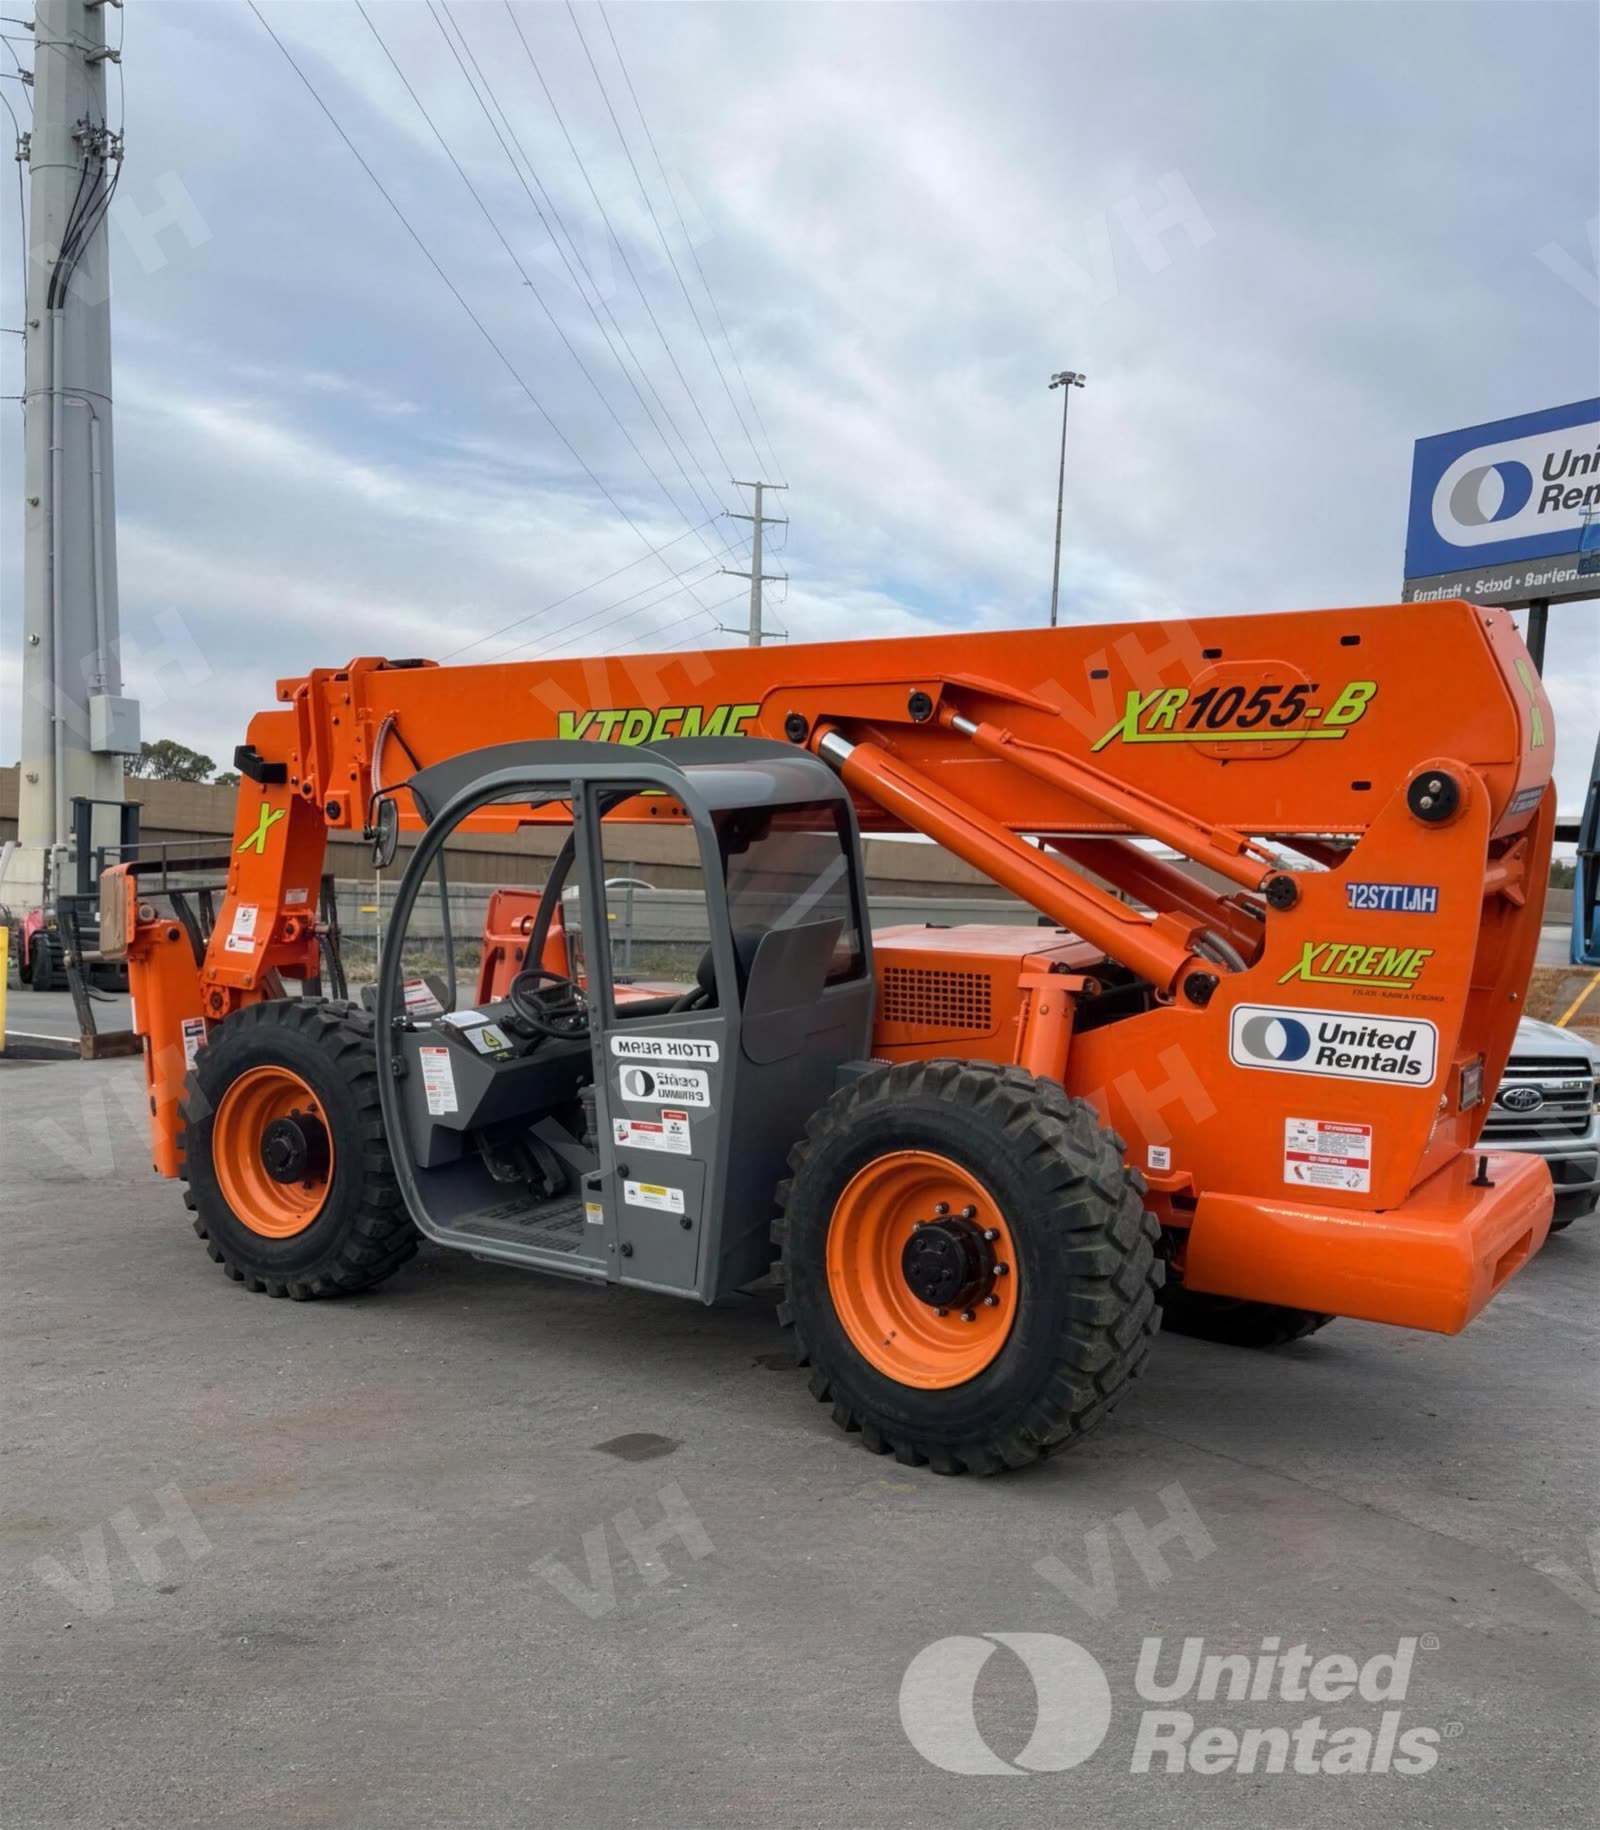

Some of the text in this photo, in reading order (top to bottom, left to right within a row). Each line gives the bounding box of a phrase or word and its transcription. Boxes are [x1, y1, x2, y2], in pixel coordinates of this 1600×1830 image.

[1090, 681, 1378, 752] XR1055-B
[1276, 942, 1434, 989] XTREME
[1318, 1022, 1417, 1051] United
[1315, 1046, 1422, 1075] Rentals
